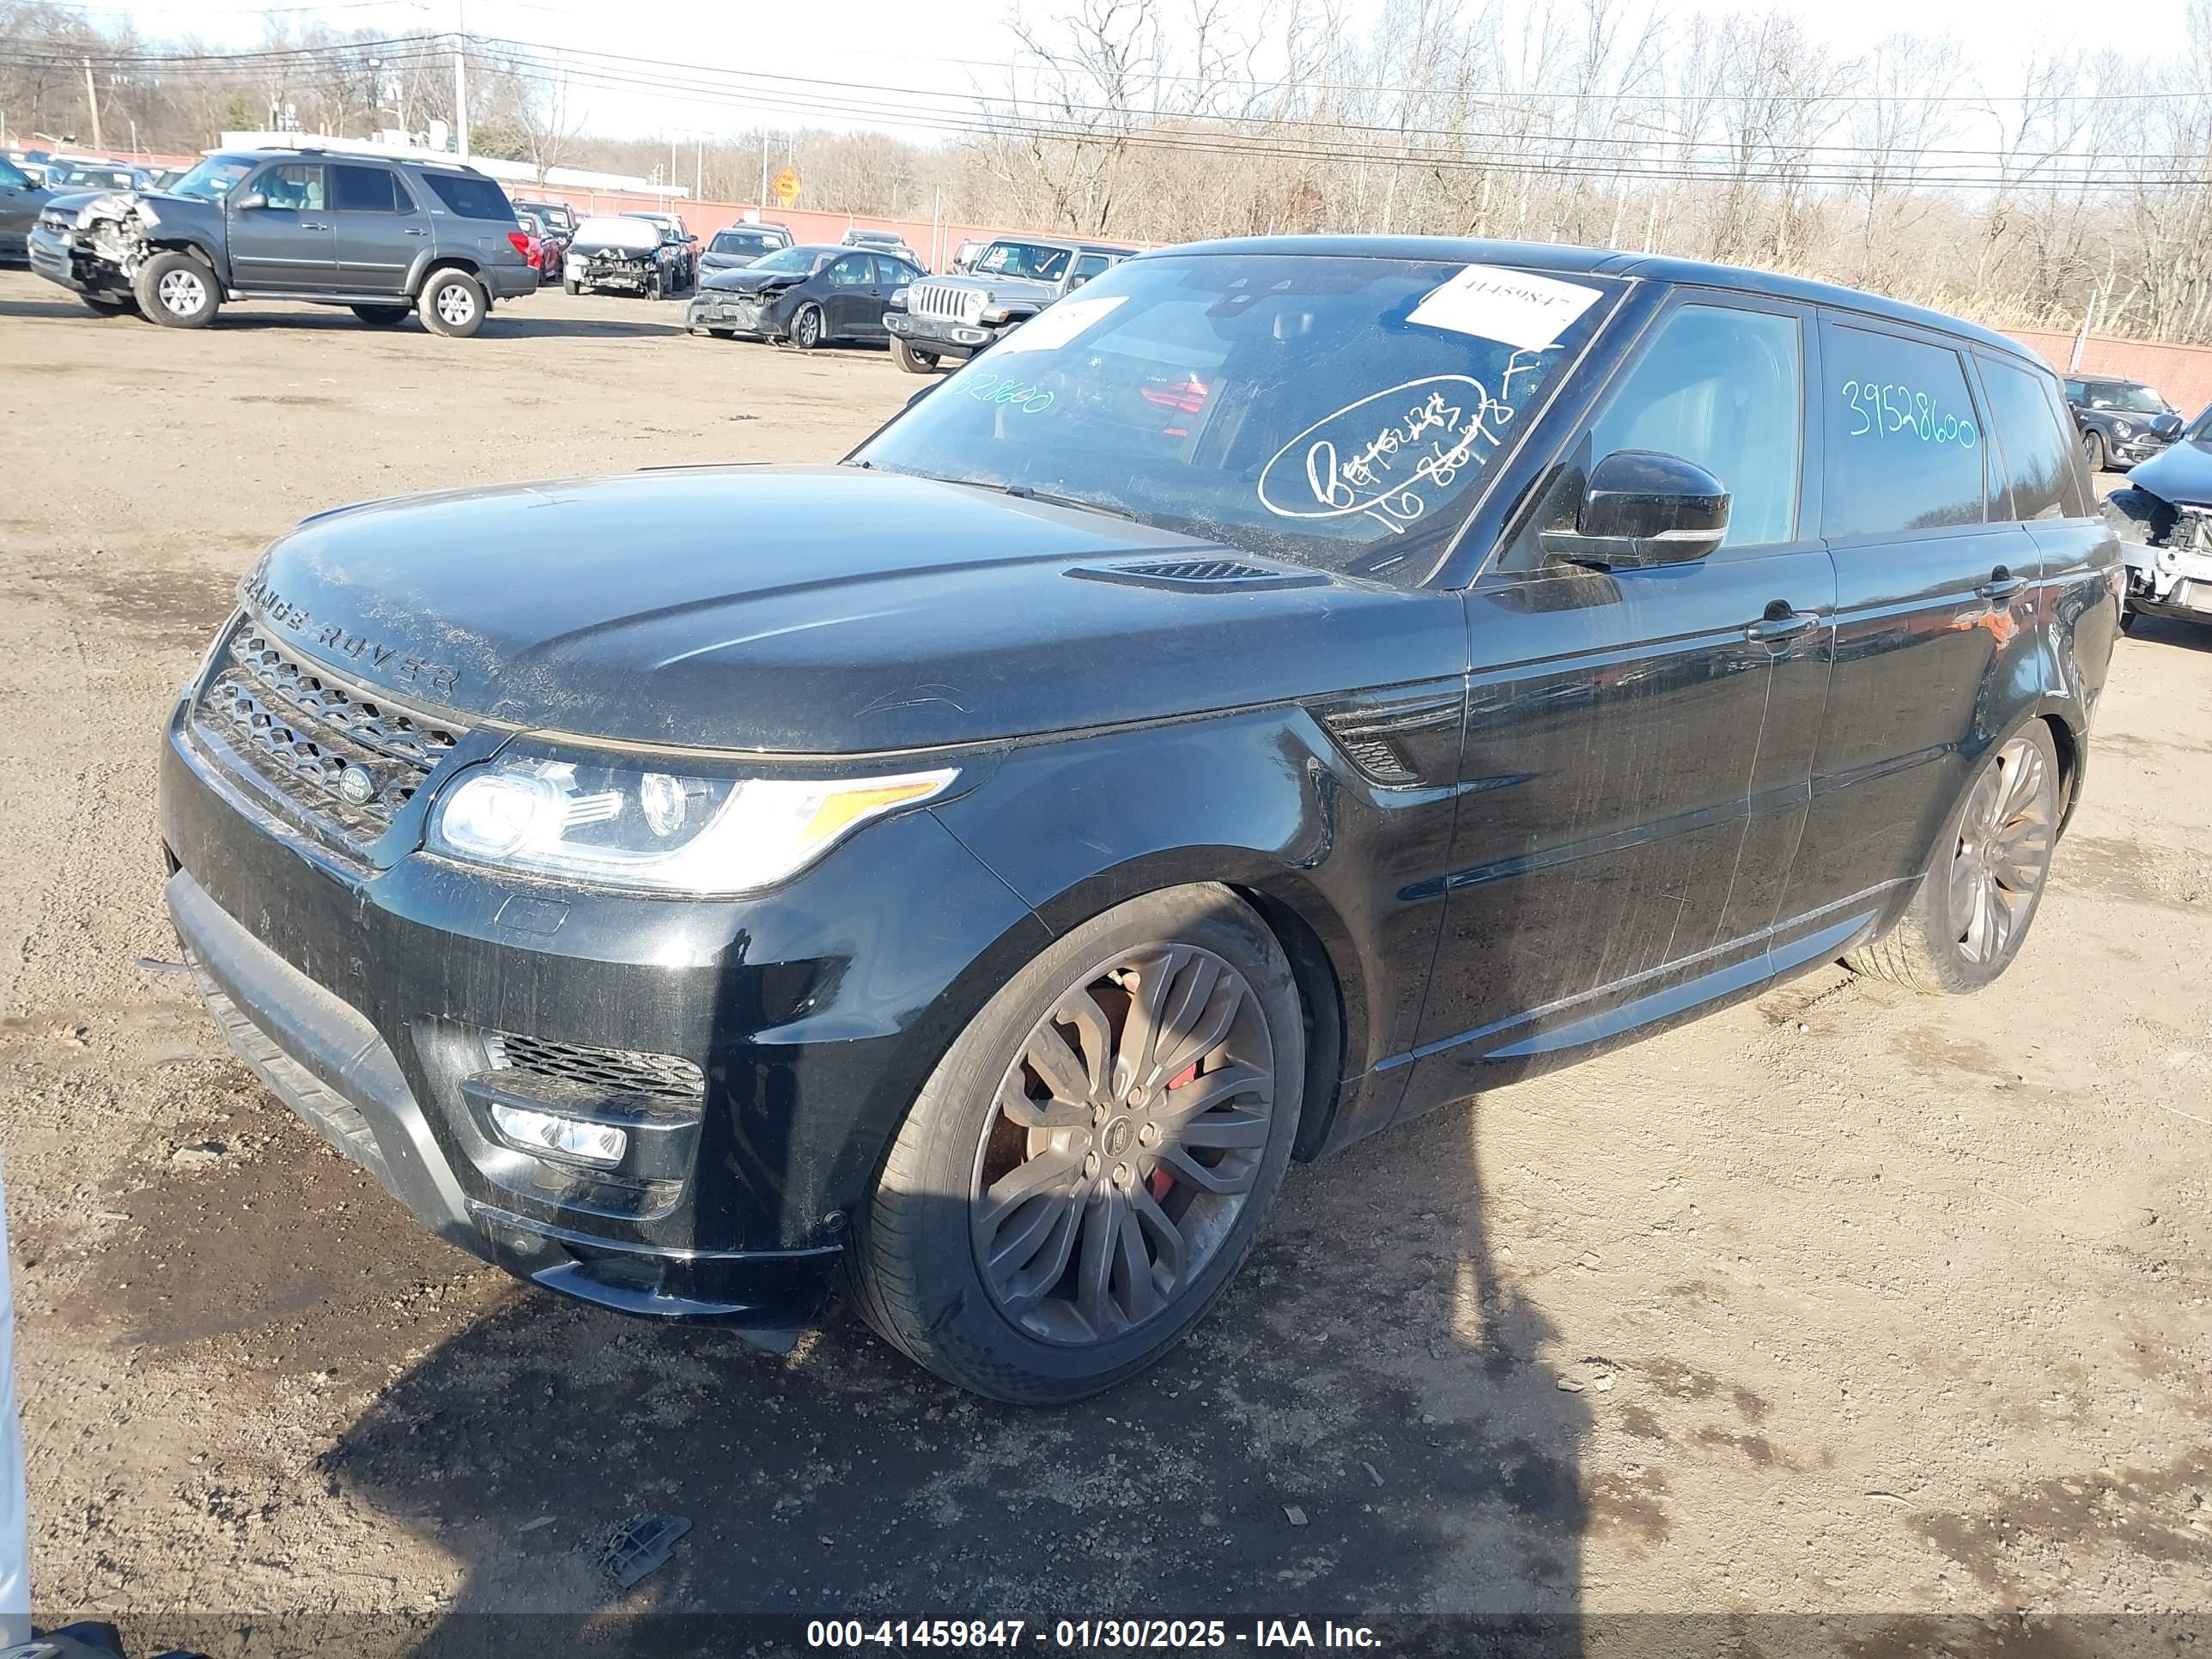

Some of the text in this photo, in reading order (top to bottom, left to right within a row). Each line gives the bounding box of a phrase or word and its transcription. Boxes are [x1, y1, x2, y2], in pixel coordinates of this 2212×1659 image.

[1842, 380, 1976, 448] 39528600
[319, 627, 462, 696] ROVER
[343, 781, 365, 799] ROVER
[344, 771, 362, 786] LAND
